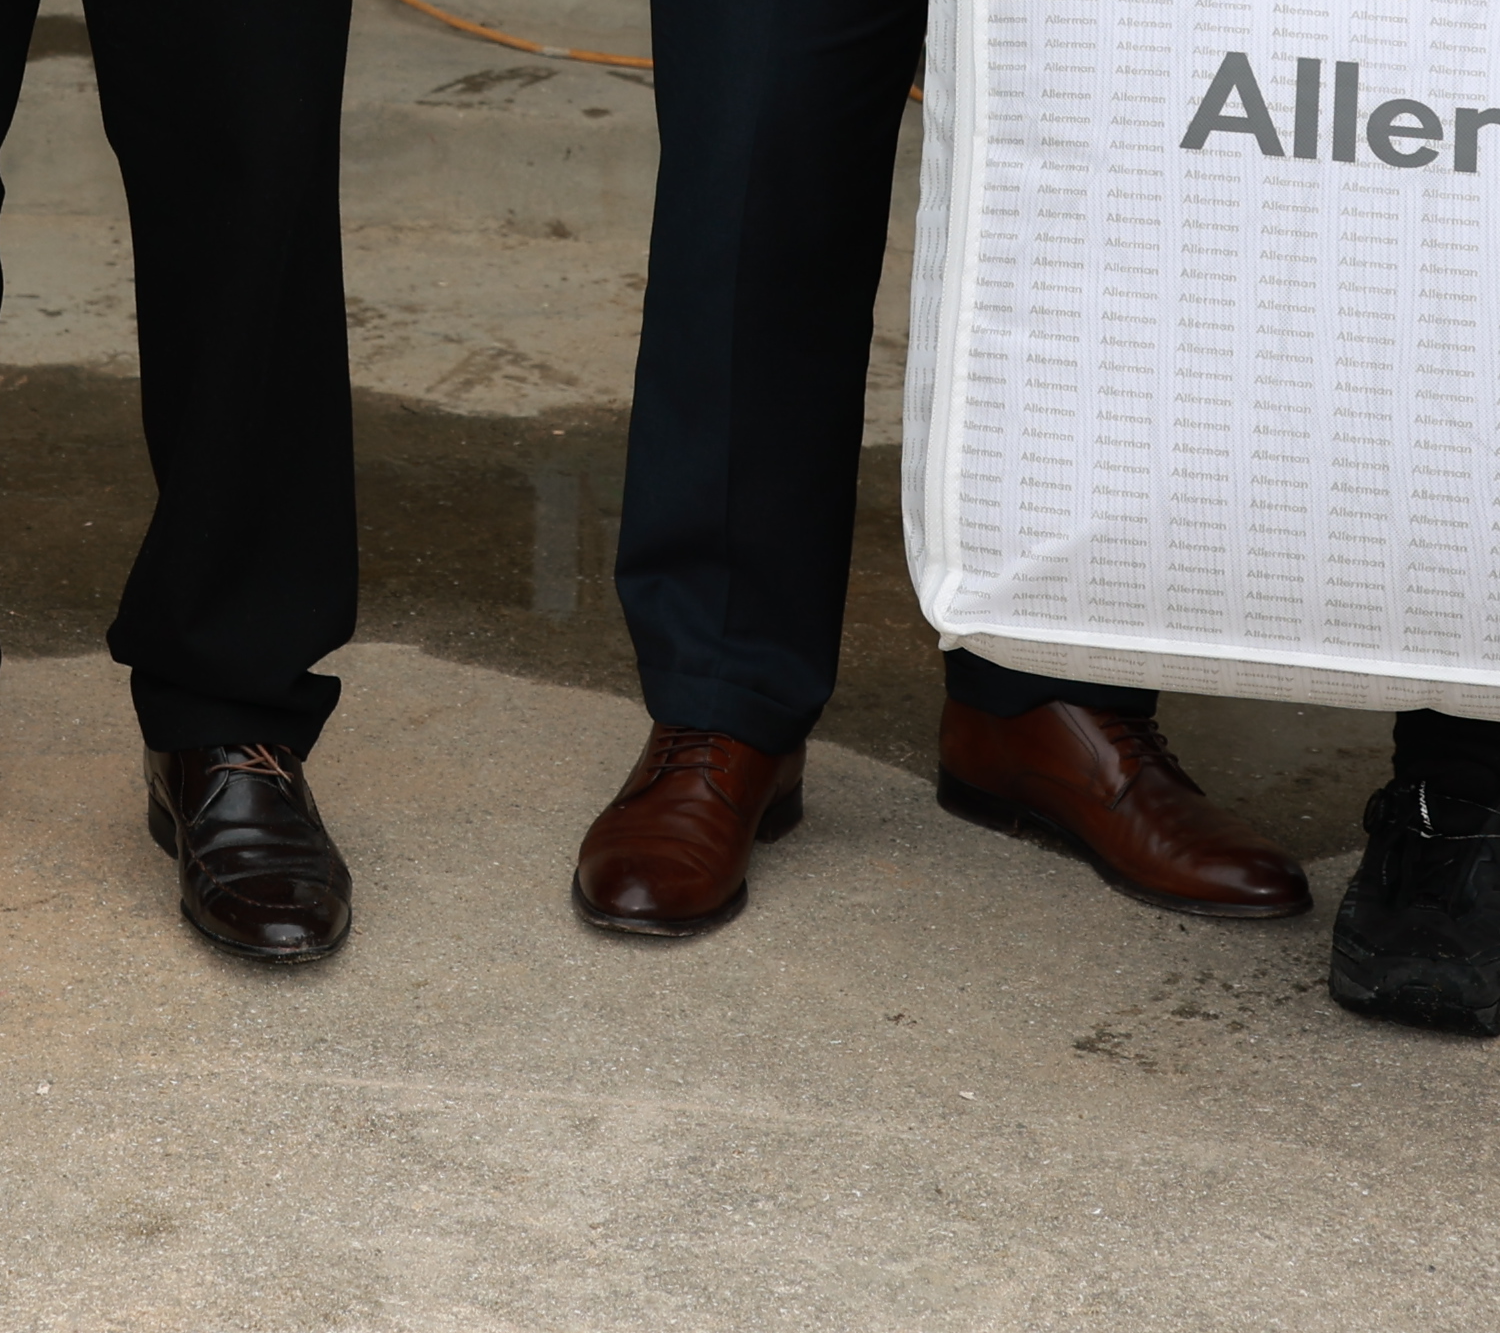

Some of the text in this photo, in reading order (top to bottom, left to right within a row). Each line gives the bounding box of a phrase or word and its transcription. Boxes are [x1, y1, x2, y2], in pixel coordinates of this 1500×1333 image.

[1116, 41, 1173, 54] Allerman
[1350, 33, 1408, 48] Allerman
[1040, 87, 1092, 101] Allerman
[1422, 188, 1481, 203] Allerman
[1261, 199, 1320, 215] Allerman
[1105, 211, 1162, 228] Allerman
[1031, 255, 1086, 271] Allerman
[1179, 267, 1238, 283] Allerman
[1337, 305, 1397, 322] Allerman
[1175, 341, 1235, 358] Allerman
[1025, 352, 1079, 370] Allerman
[1095, 409, 1155, 427] Allerman
[1332, 406, 1394, 423] Allerman
[1020, 451, 1074, 467] Allerman
[1250, 448, 1311, 465] Allerman
[1329, 480, 1392, 498] Allerman
[1169, 491, 1229, 508] Allerman
[1408, 513, 1471, 530] Allerman
[1088, 533, 1150, 547] Allerman
[1247, 546, 1307, 562] Allerman
[1013, 570, 1070, 585] Allerman
[1165, 582, 1226, 597] Allerman
[1321, 616, 1383, 634] Allerman
